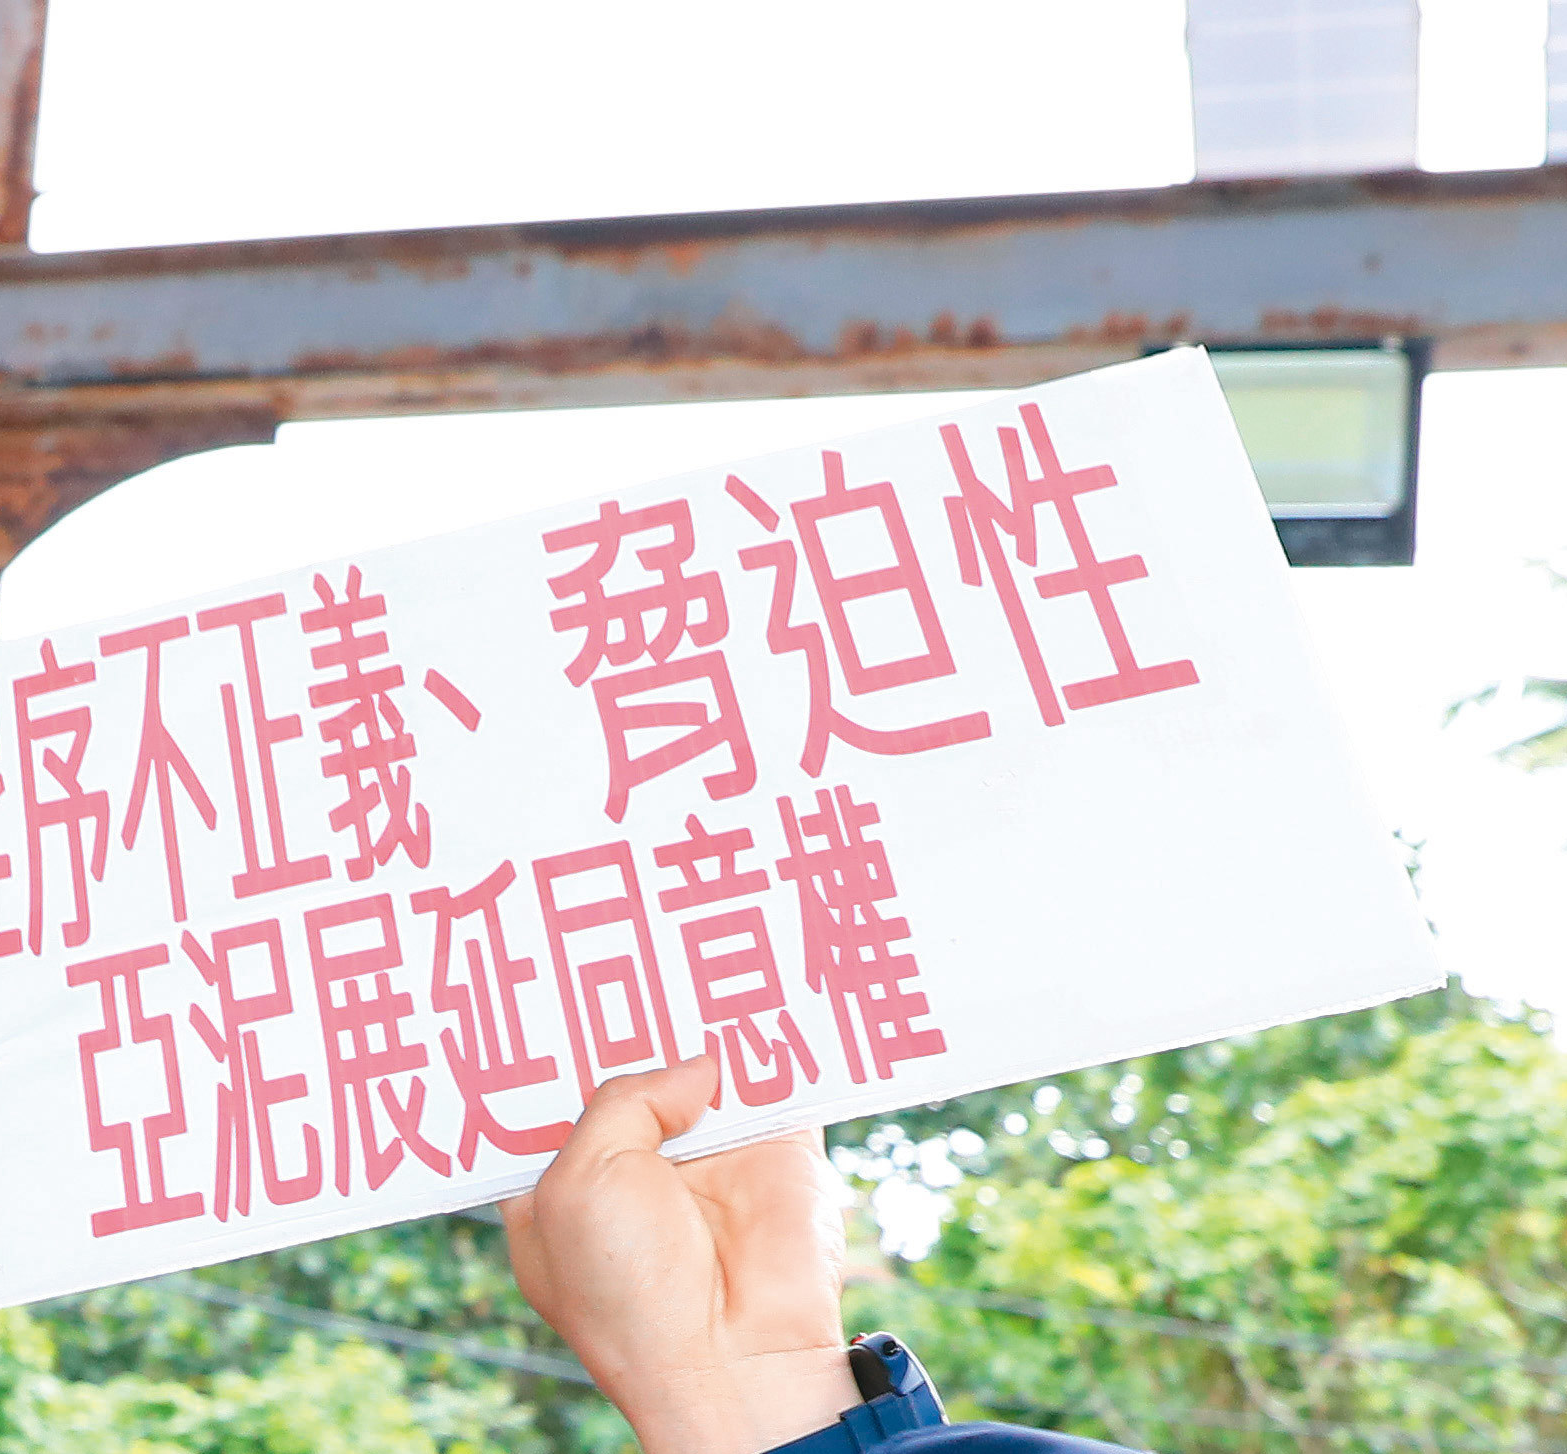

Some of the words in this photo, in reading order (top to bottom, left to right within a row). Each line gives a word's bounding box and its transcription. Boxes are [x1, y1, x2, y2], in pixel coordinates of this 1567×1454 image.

[66, 785, 946, 1237] 亞泥展延同意權
